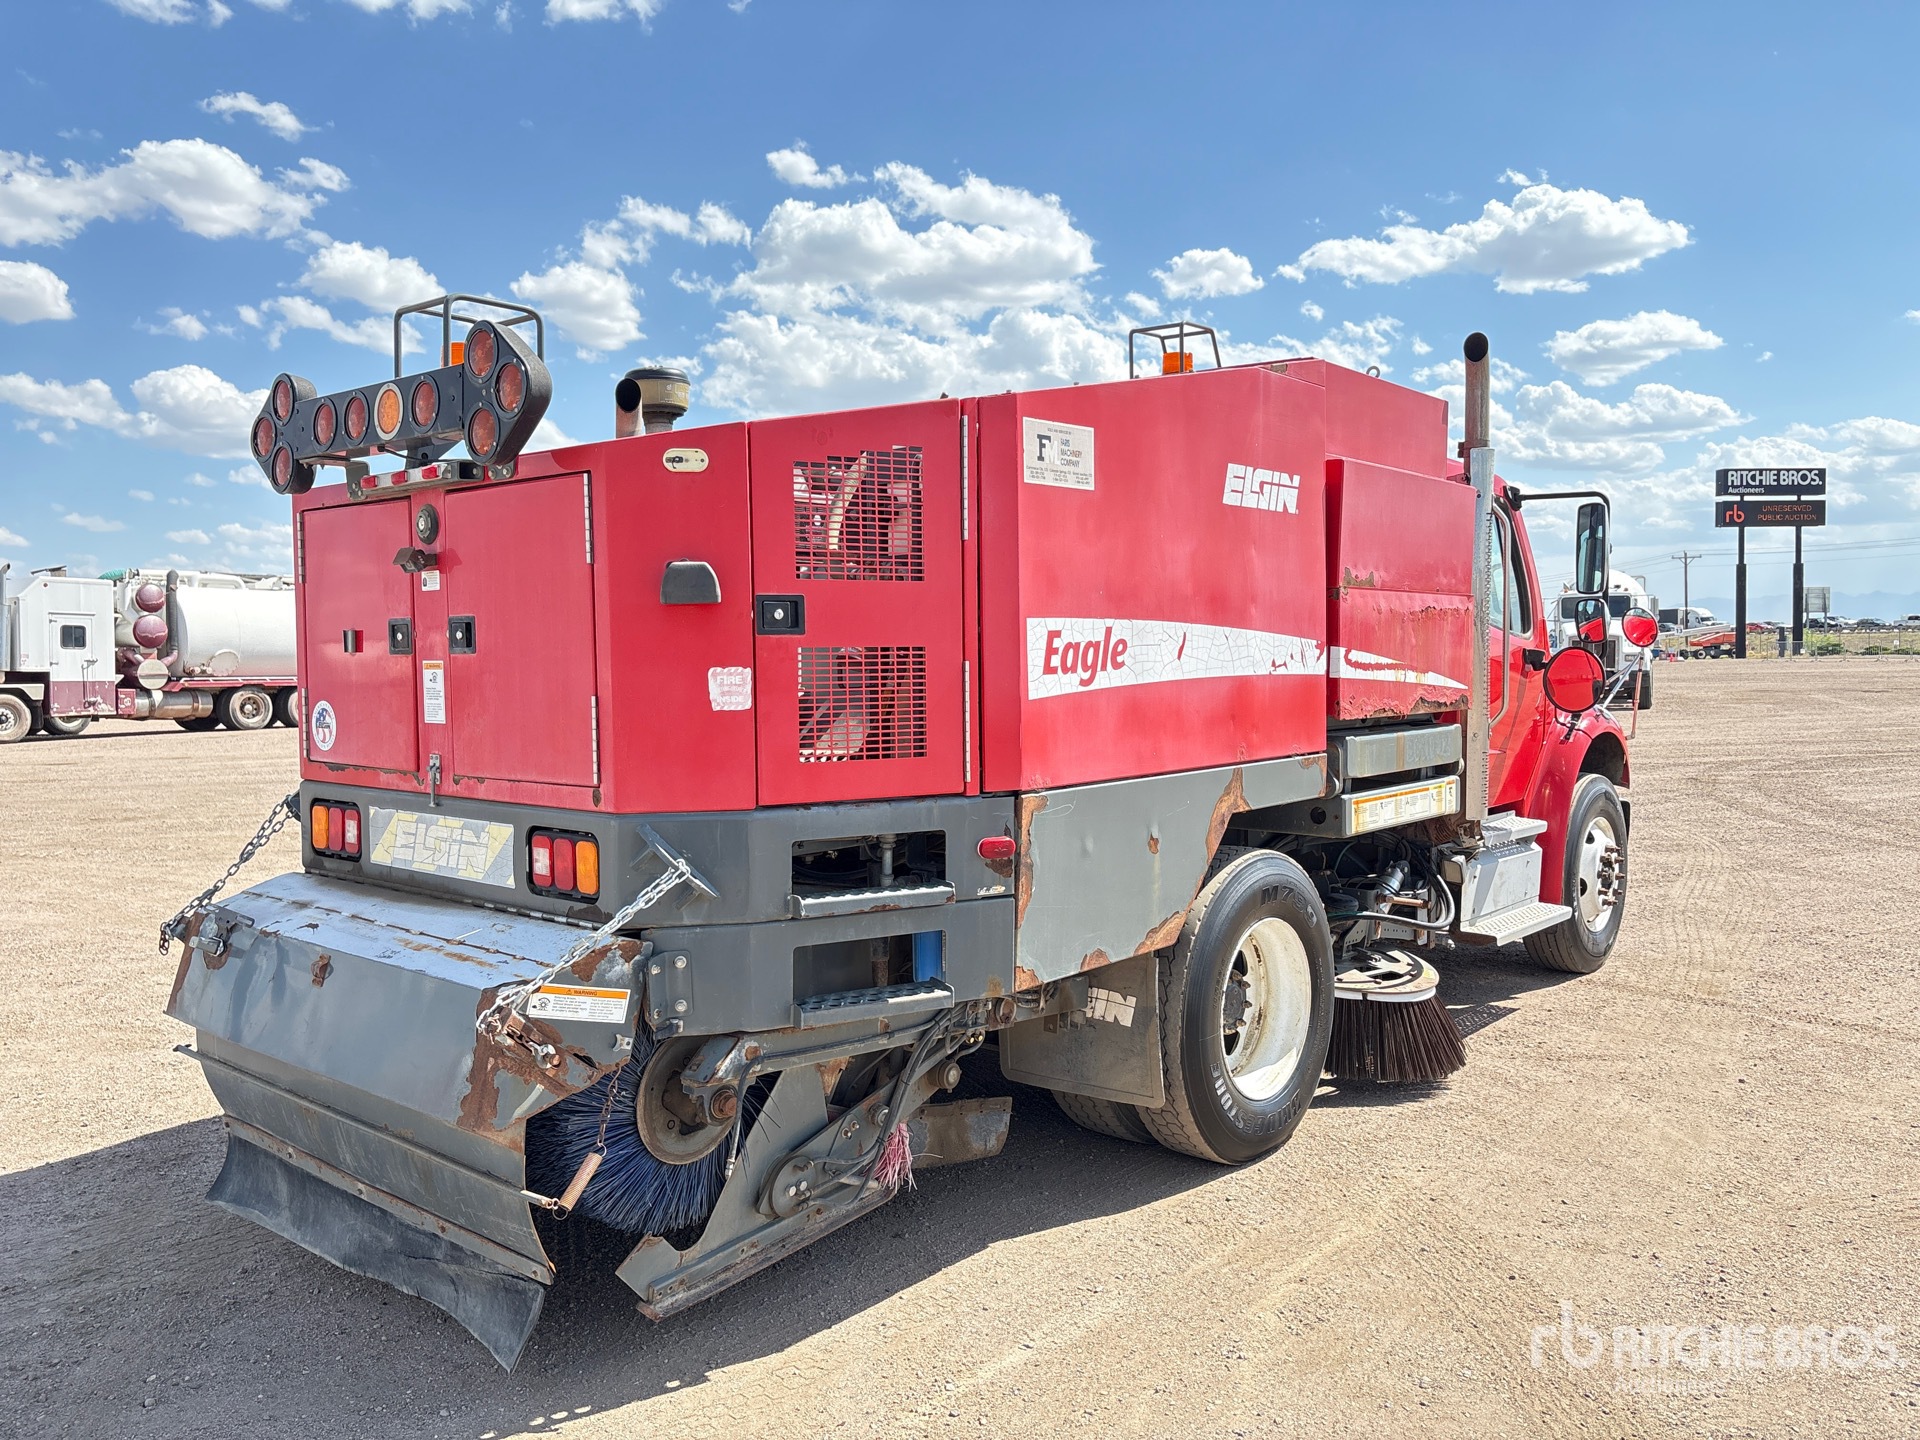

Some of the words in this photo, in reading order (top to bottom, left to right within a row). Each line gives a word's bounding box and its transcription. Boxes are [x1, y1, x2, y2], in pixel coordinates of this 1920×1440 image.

[1727, 470, 1778, 486] RITCHIE
[1780, 470, 1823, 486] BROS.
[1222, 462, 1301, 515] ELGIN
[1727, 486, 1765, 494] Auctioneers
[1785, 513, 1817, 521] AUCTION
[1042, 626, 1128, 687] Eagle
[716, 675, 744, 685] FIRE
[393, 820, 490, 874] ELGIN
[573, 989, 598, 997] WARNING
